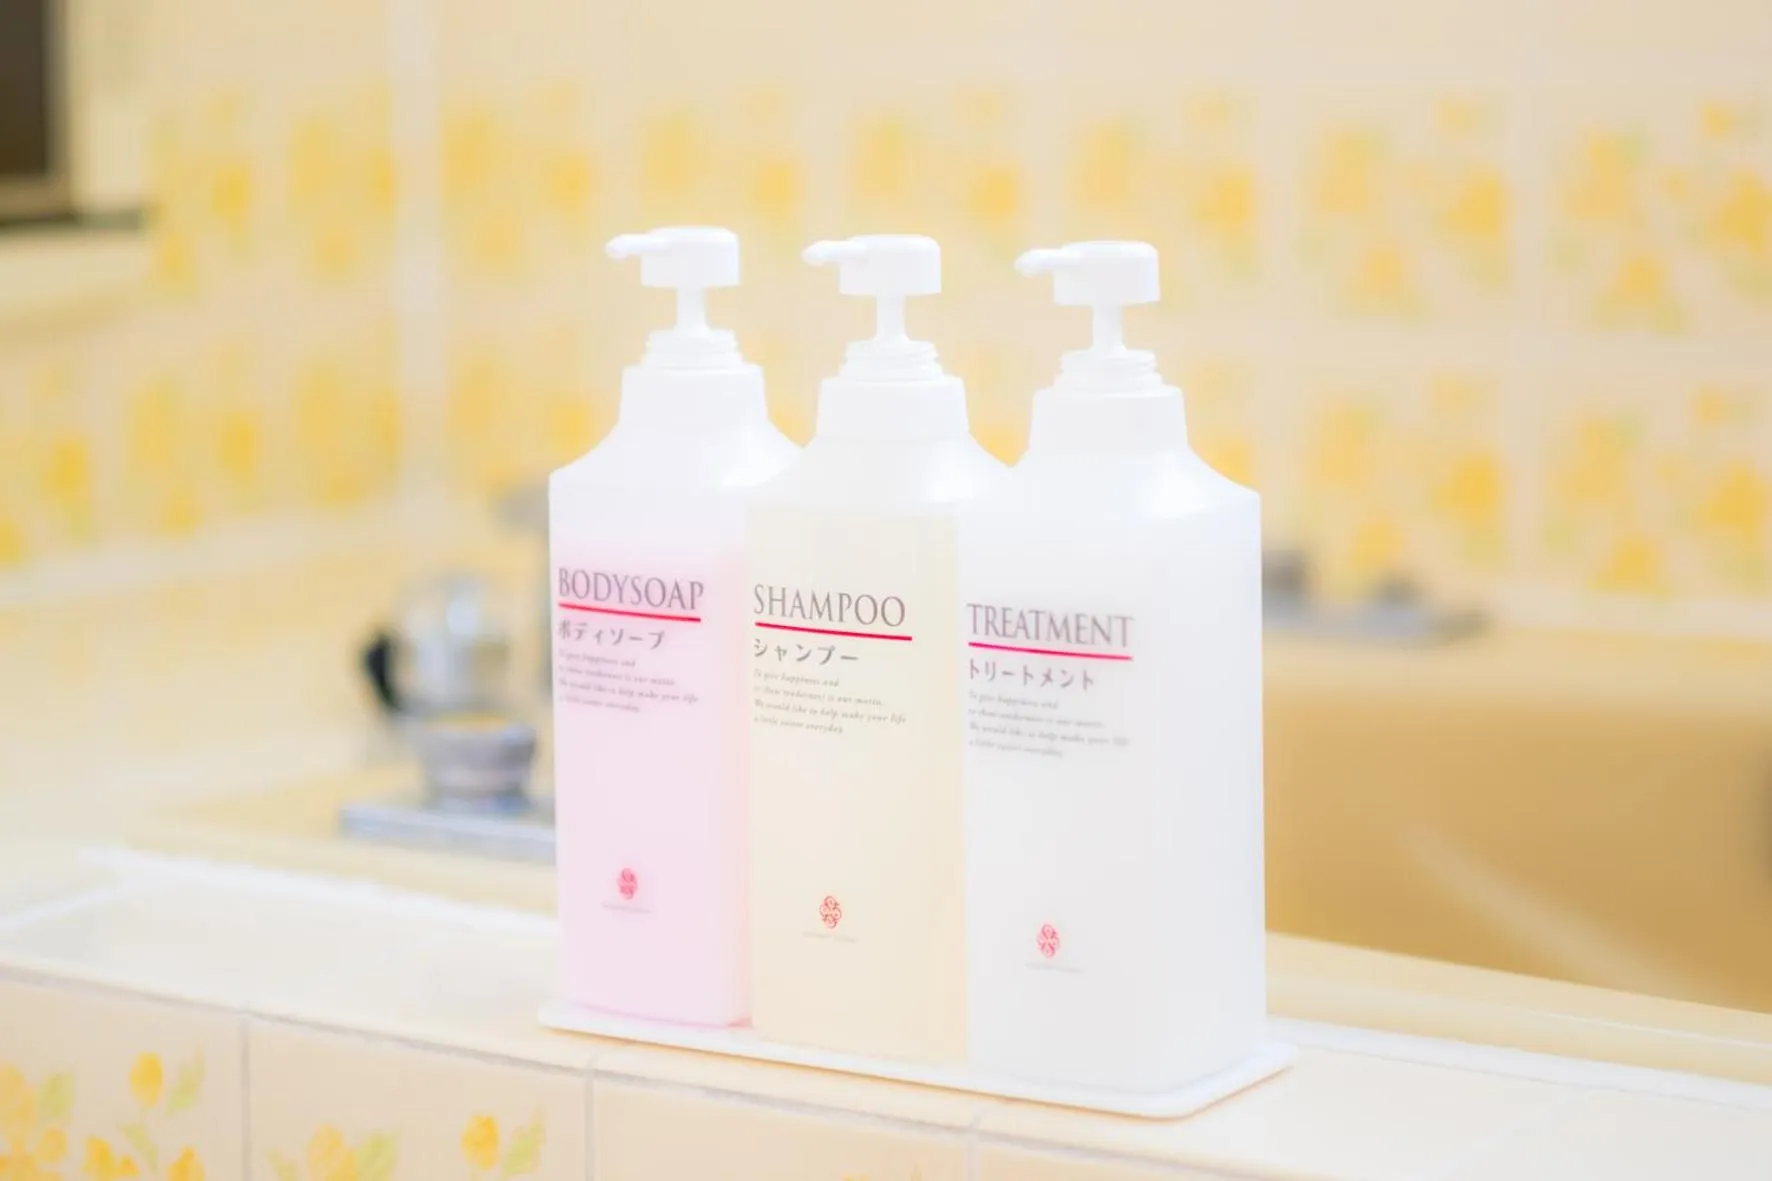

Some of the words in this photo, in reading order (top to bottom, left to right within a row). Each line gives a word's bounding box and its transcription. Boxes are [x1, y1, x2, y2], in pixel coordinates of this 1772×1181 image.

[558, 567, 704, 610] BODYSOAP
[754, 583, 906, 628] SHAMPOO
[558, 619, 666, 651] ボディソープ
[966, 603, 1136, 648] TREATMENT
[754, 637, 860, 666] シャンプー
[780, 671, 821, 686] happiness
[822, 677, 840, 688] and
[969, 657, 1095, 692] トリートメント
[765, 702, 790, 712] would
[791, 704, 808, 714] like
[819, 706, 839, 721] help
[841, 710, 865, 720] make
[866, 714, 889, 724] your
[890, 711, 908, 726] life
[836, 696, 853, 704] our
